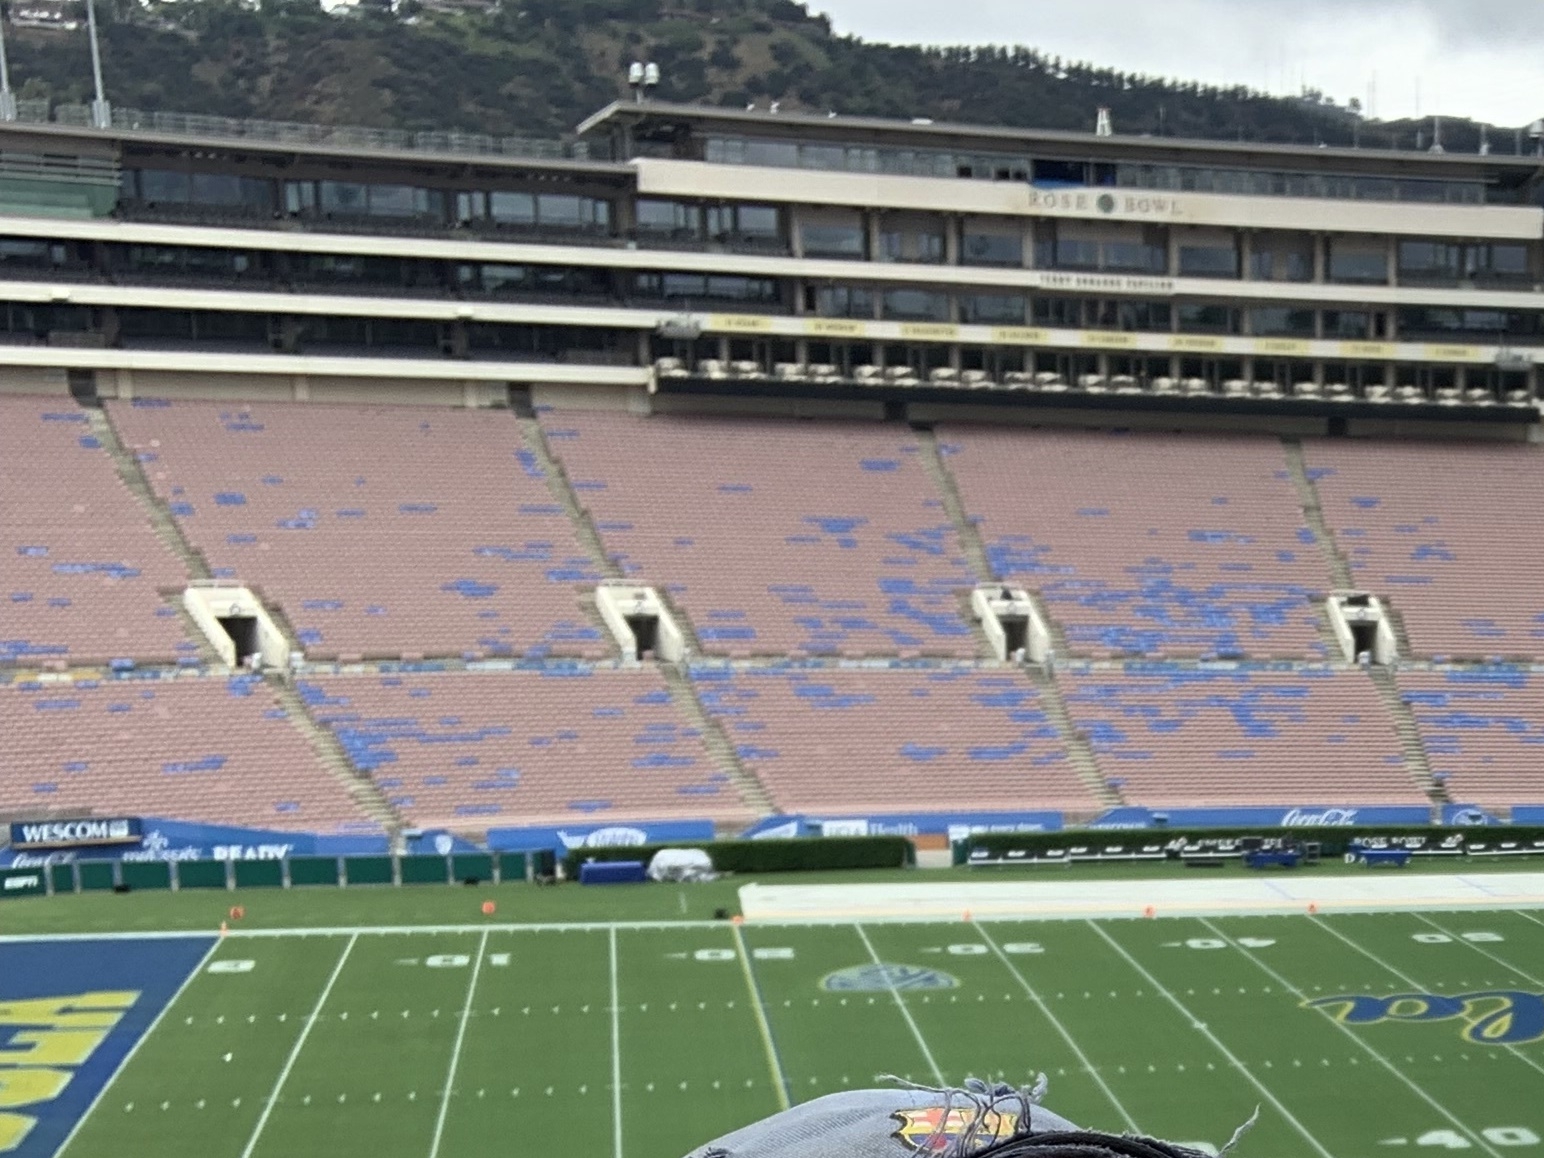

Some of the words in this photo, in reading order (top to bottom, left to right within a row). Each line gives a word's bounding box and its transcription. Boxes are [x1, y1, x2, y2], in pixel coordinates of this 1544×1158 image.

[1281, 808, 1358, 827] Coca-Cola
[22, 822, 107, 842] WESCOM
[1416, 1126, 1541, 1149] 40
